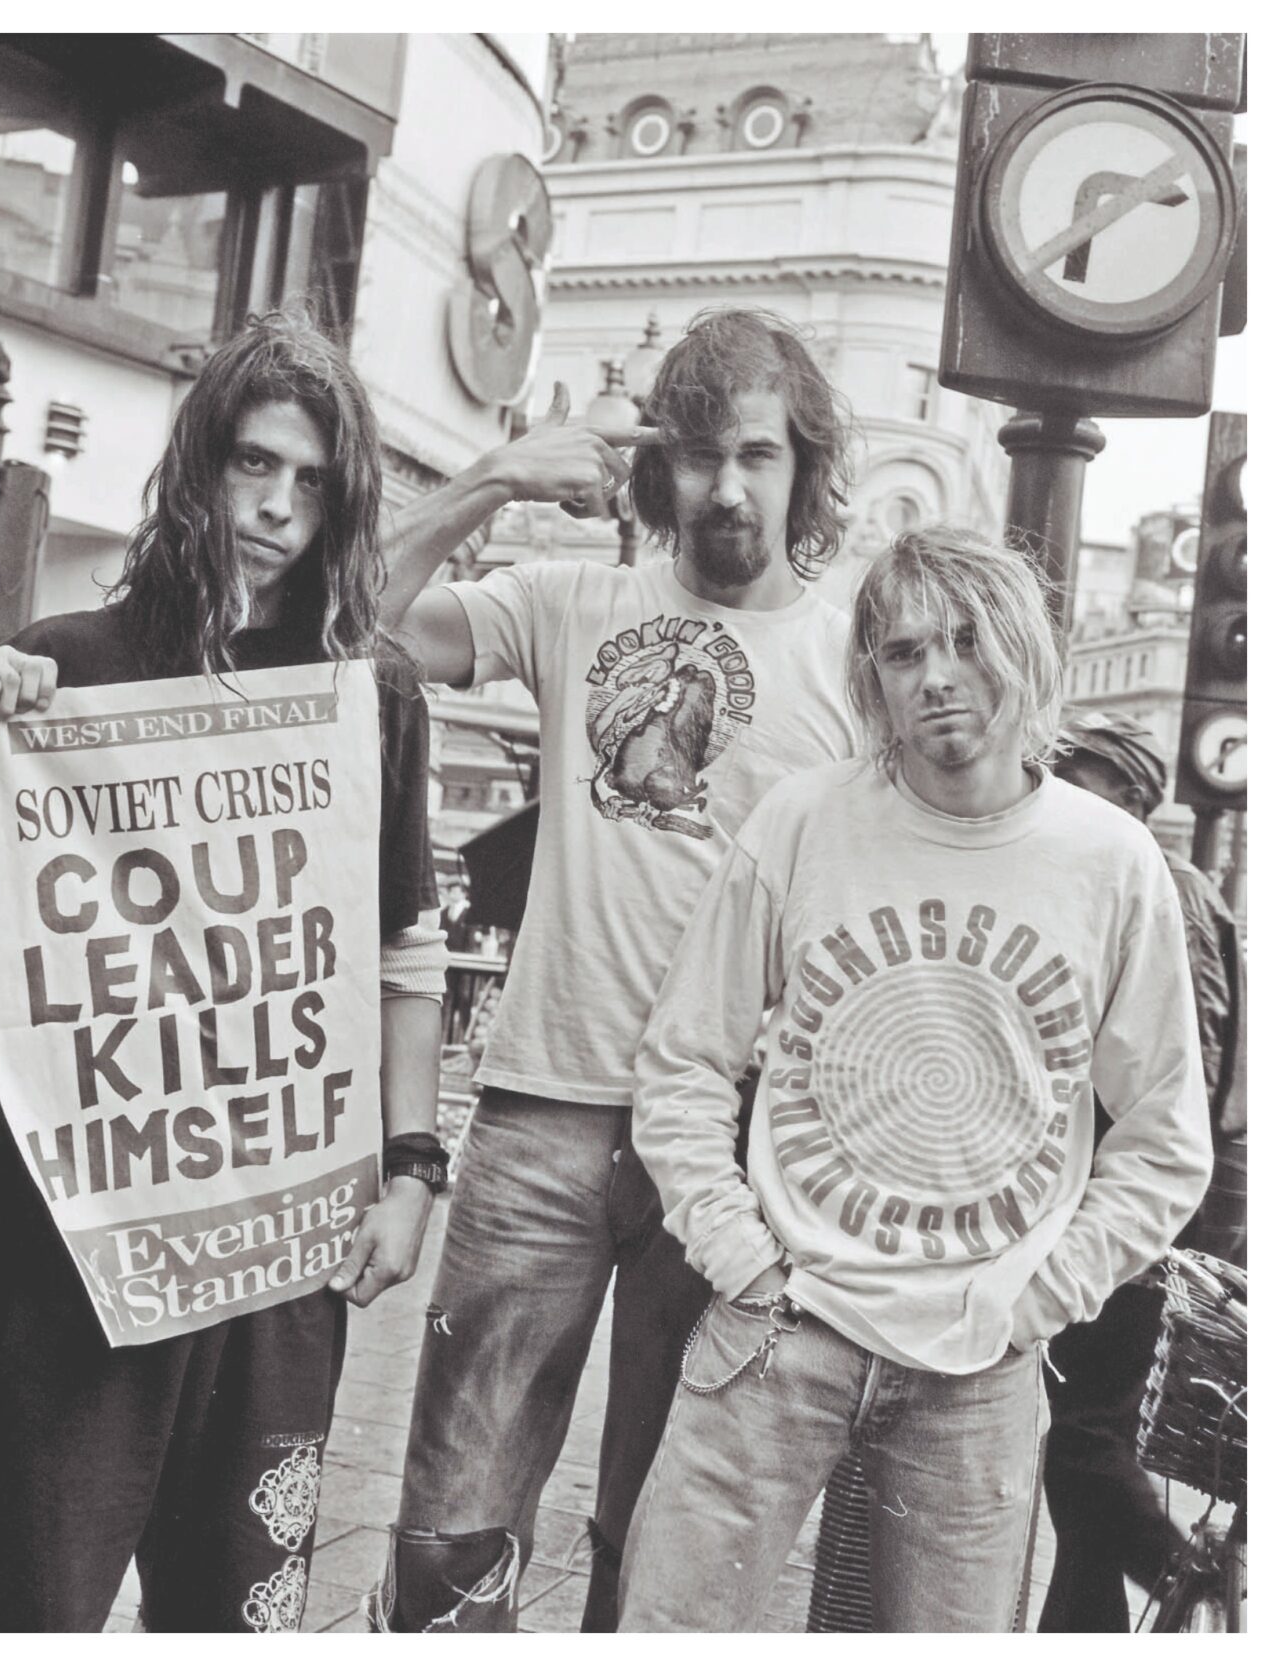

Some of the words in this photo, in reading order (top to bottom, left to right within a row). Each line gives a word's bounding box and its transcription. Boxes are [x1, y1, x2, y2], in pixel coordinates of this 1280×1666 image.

[22, 720, 126, 751] WEST
[136, 711, 212, 740] END
[221, 699, 329, 731] FINAL
[586, 614, 723, 686] LOOKIN'
[703, 634, 755, 725] GOOD!
[15, 776, 182, 842] SOVIET
[194, 759, 332, 824] CRISIS
[36, 828, 308, 935] COUP
[23, 906, 336, 1027] LEADER
[779, 899, 946, 1061] SOUNDS
[957, 904, 1091, 1104] SOUNDS
[73, 990, 327, 1110] KILLS
[26, 1069, 353, 1202] HIMSELF
[106, 1178, 358, 1279] Evening
[122, 1204, 370, 1328] Standar
